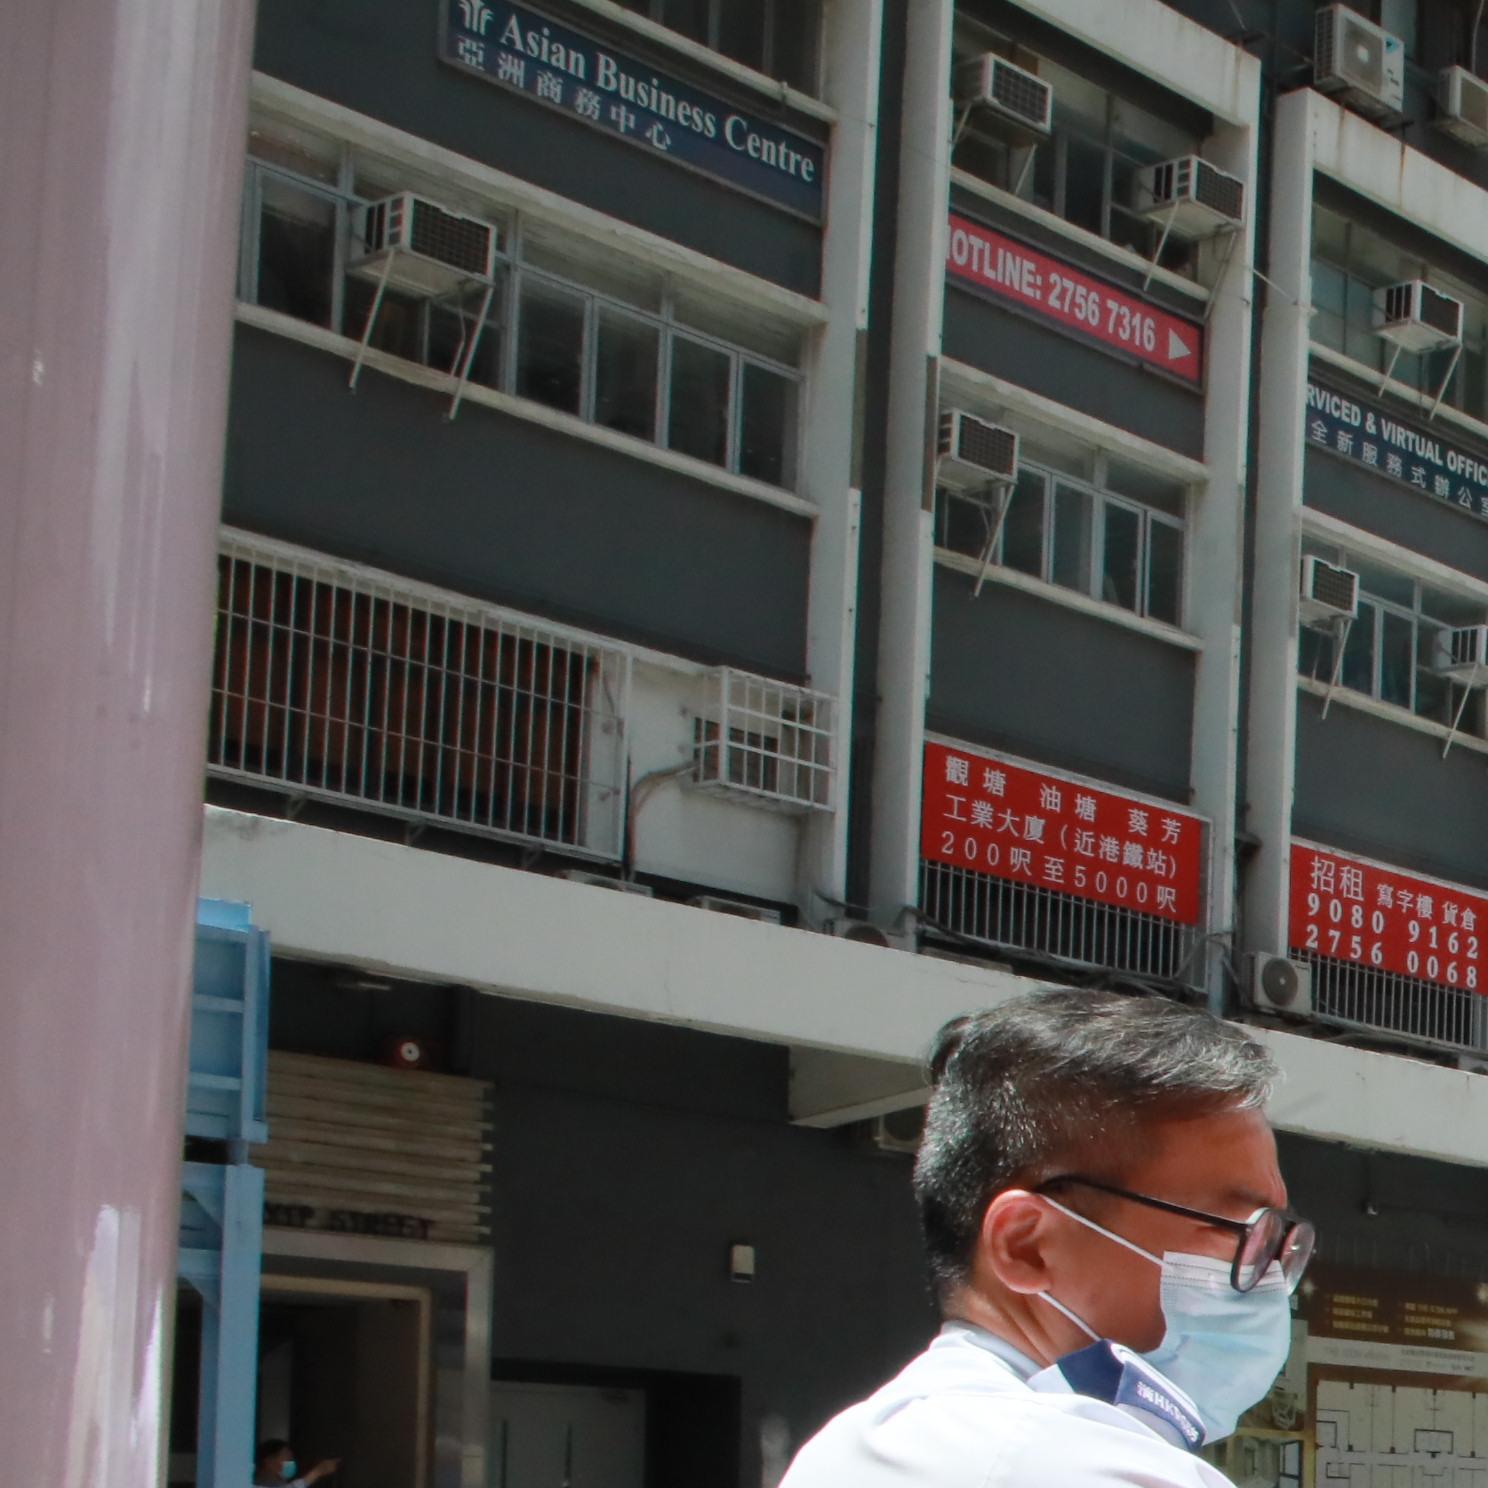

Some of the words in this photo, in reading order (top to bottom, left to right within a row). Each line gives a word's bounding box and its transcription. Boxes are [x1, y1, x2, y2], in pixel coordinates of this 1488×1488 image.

[457, 38, 672, 152] 亞洲商務中心
[500, 13, 586, 80] Asian
[596, 52, 716, 139] Business
[725, 112, 815, 183] Centre
[945, 225, 1043, 300] OTLINE:
[1047, 273, 1100, 327] 2756
[1106, 299, 1157, 352] 7316
[1365, 412, 1377, 436] &
[1381, 418, 1443, 467] VIRTUAL
[945, 755, 1007, 798] 觀塘
[1039, 782, 1097, 823] 油塘
[1127, 808, 1182, 845] 葵芳
[1308, 892, 1385, 934] 9080
[1408, 920, 1478, 960] 9162
[1311, 855, 1365, 902] 招租
[1376, 883, 1433, 921] 寫字樓
[1441, 901, 1477, 931] 貨倉
[1305, 924, 1383, 965] 2756
[1406, 950, 1477, 988] 0068
